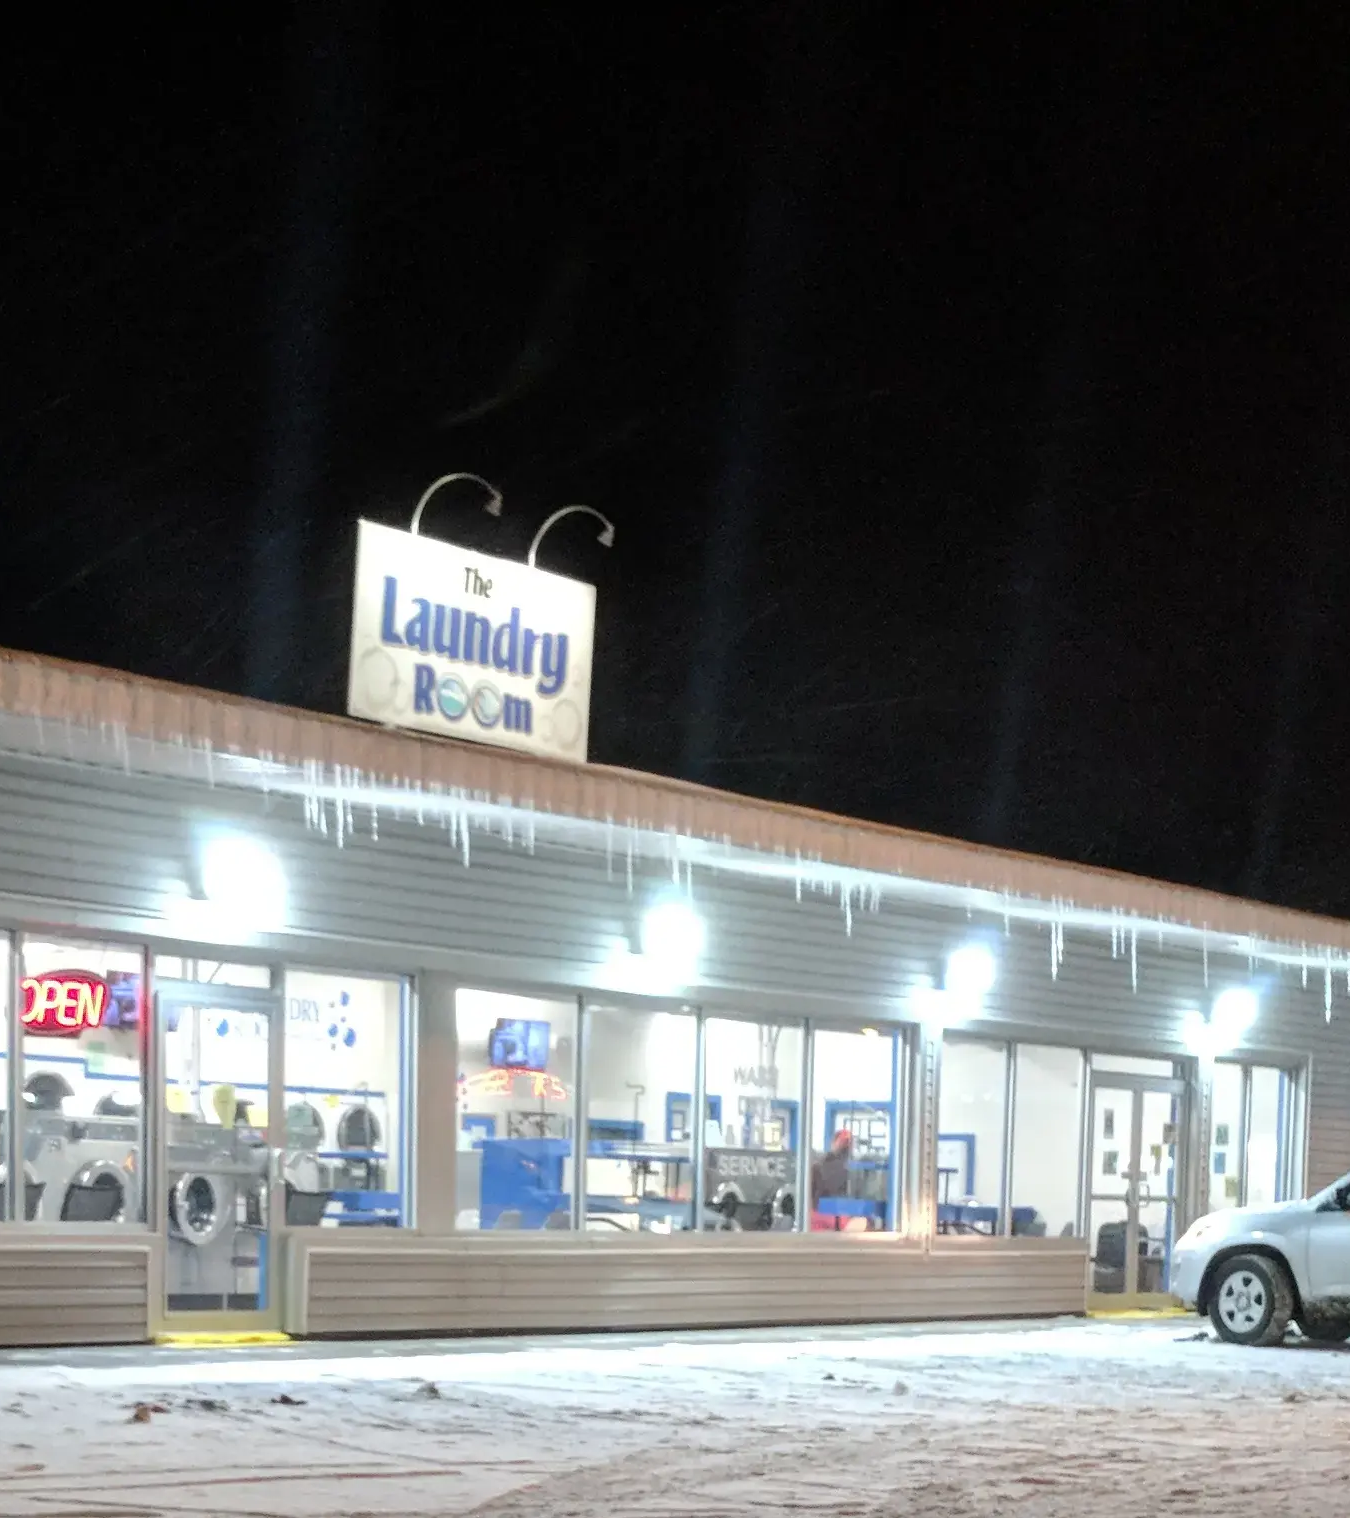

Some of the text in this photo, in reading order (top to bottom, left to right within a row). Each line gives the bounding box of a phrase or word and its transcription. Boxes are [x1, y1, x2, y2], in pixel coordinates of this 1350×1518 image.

[463, 567, 493, 598] The
[380, 575, 569, 696] Laundry
[21, 978, 104, 1027] OPEN
[718, 1154, 788, 1179] SERVICE
